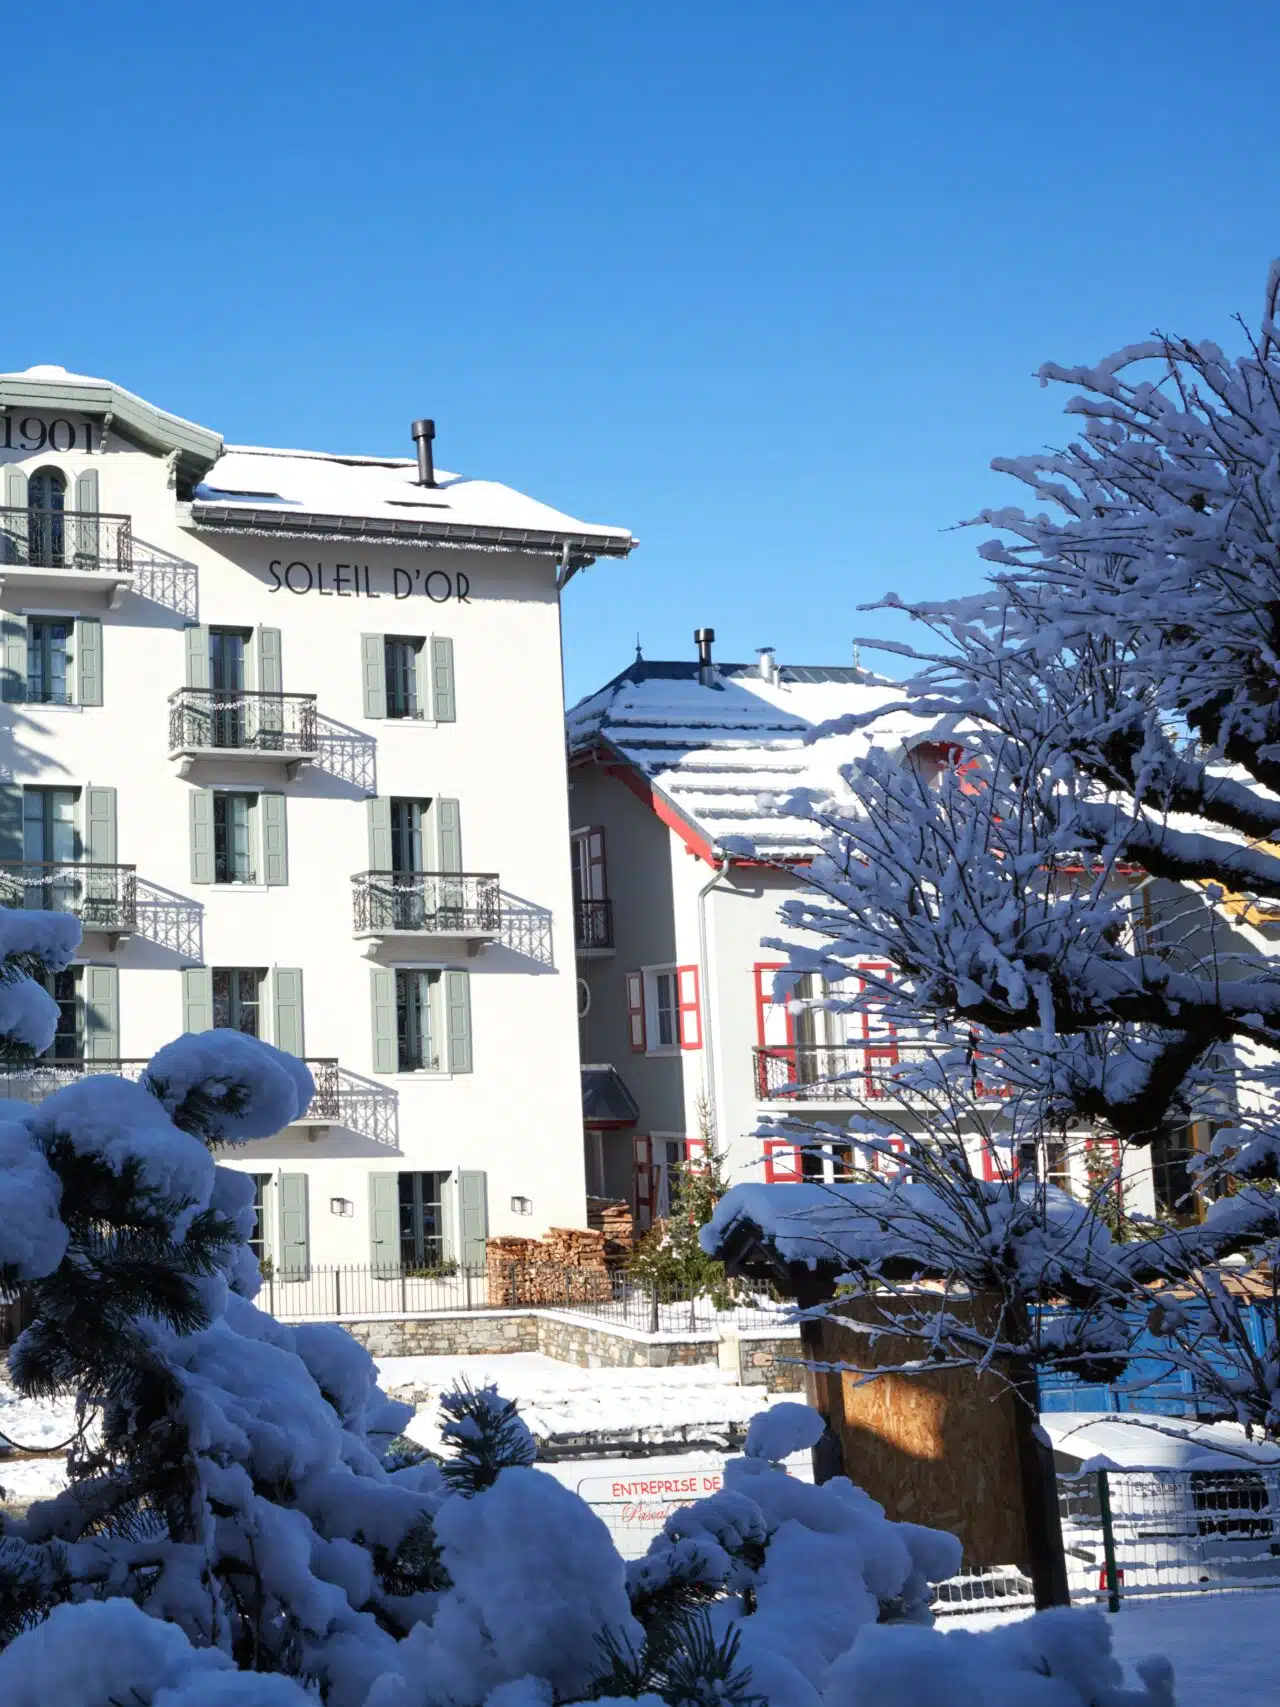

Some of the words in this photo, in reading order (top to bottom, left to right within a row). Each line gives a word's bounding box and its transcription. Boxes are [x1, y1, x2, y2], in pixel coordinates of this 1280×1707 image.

[0, 416, 98, 455] 1901
[268, 560, 381, 599] SOLEIL
[393, 568, 472, 605] D'OR
[611, 1478, 697, 1497] ENTREPRISE
[703, 1476, 721, 1491] DE
[622, 1501, 670, 1523] Pascal
